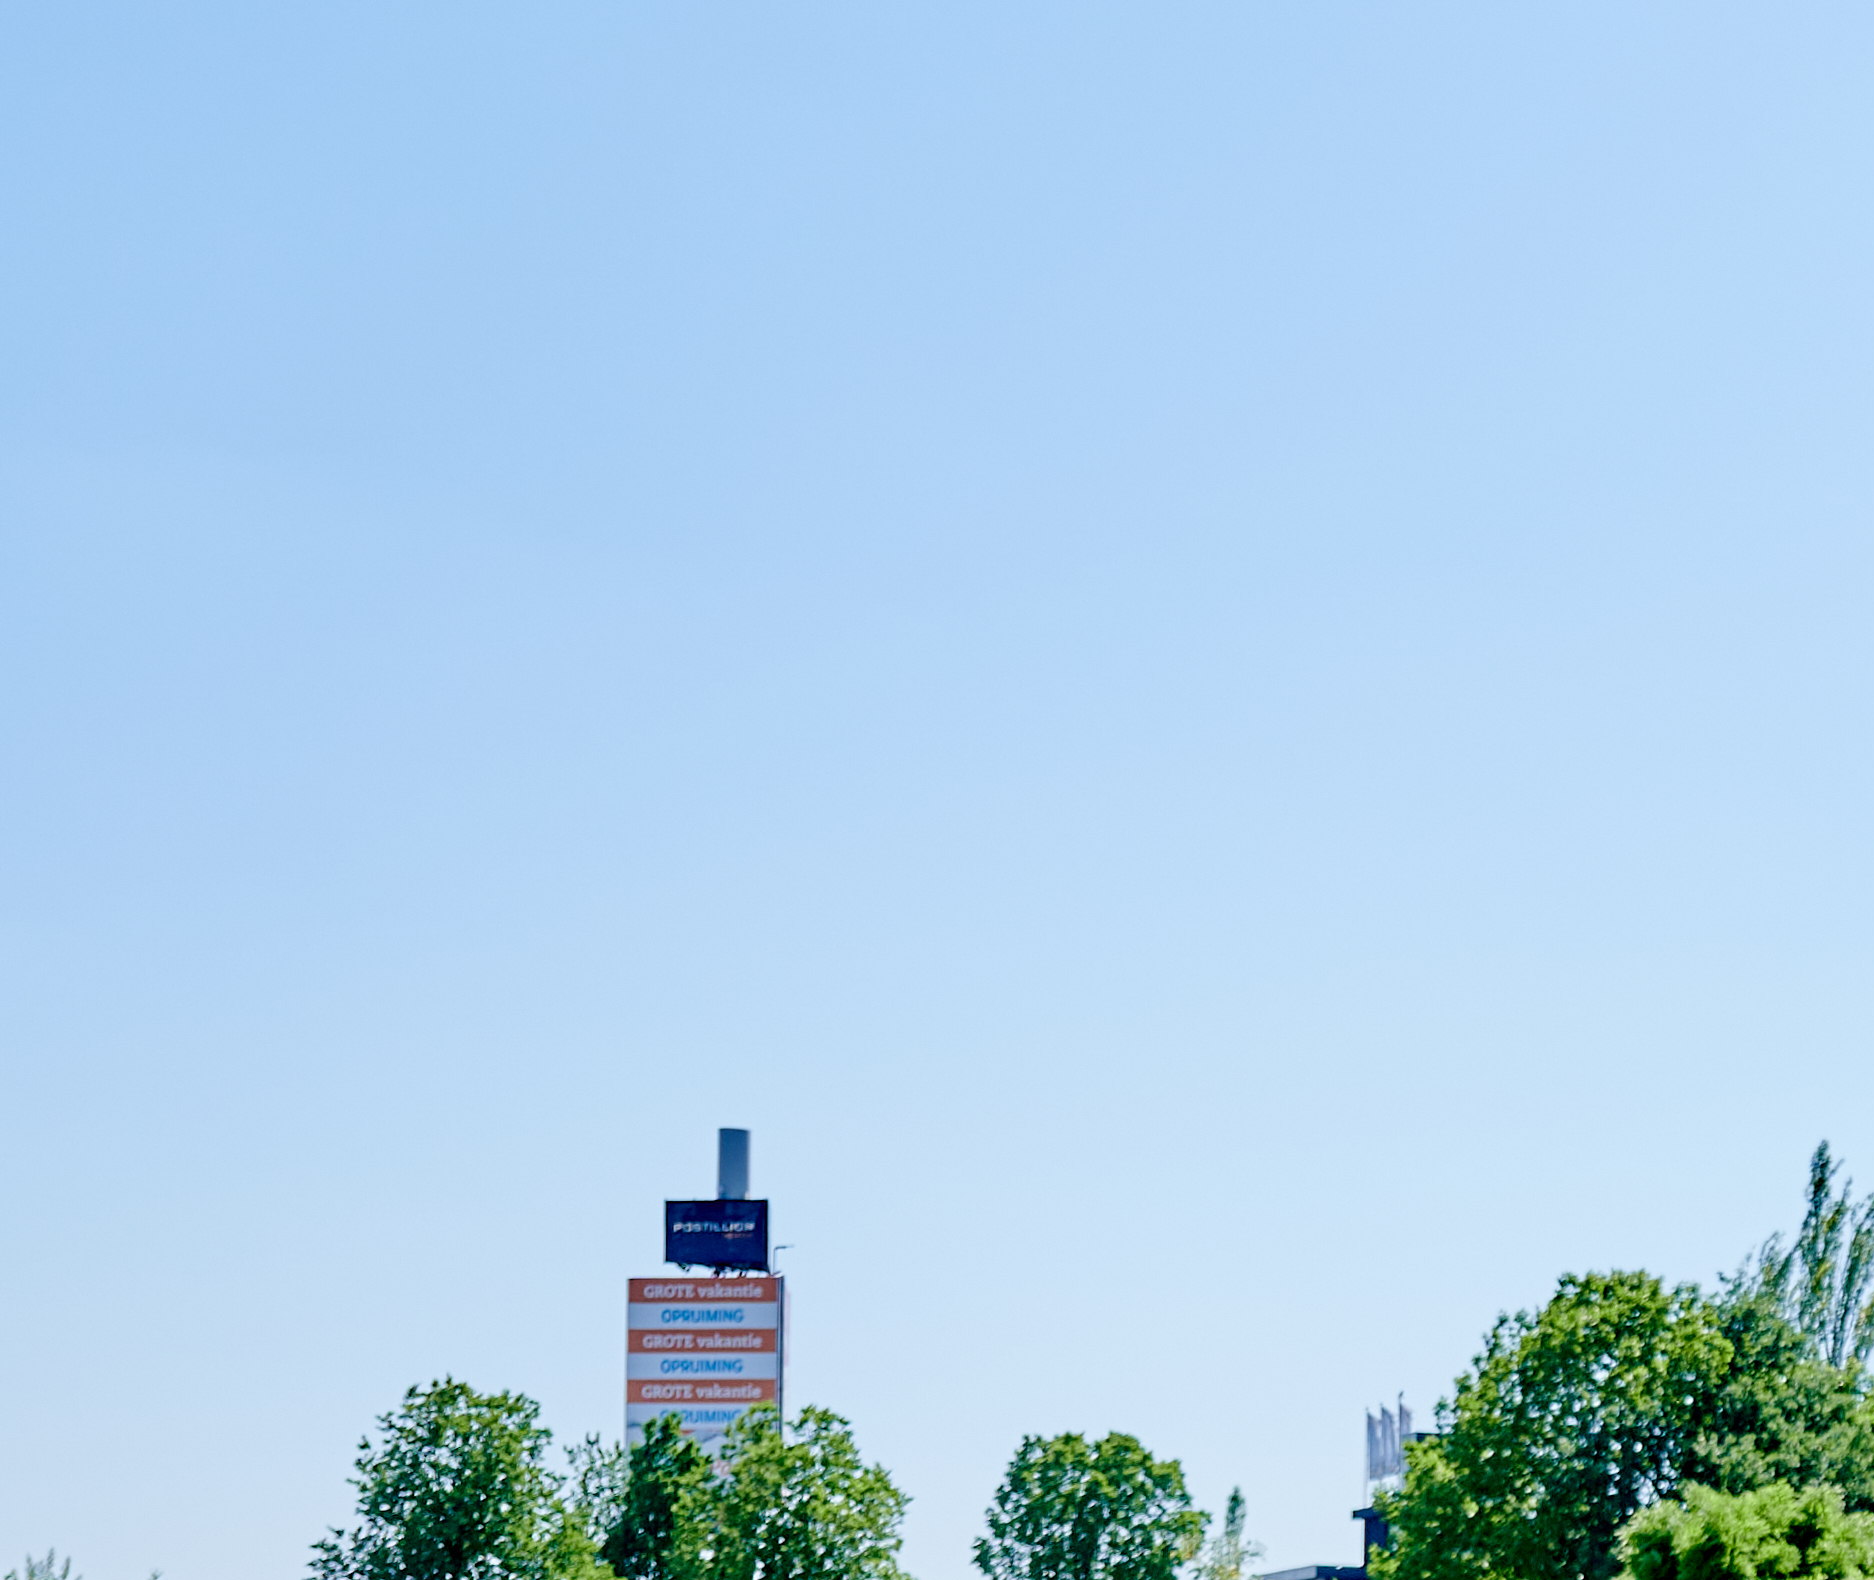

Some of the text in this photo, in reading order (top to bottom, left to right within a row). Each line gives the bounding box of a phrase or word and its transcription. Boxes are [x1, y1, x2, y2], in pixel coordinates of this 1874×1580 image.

[643, 1282, 762, 1298] GROTE vakantie
[661, 1309, 744, 1323] OPRUIMING
[642, 1332, 763, 1349] GROTE vakantie
[660, 1358, 743, 1373] OPRUIMING
[641, 1382, 762, 1399] GROTE vakantie
